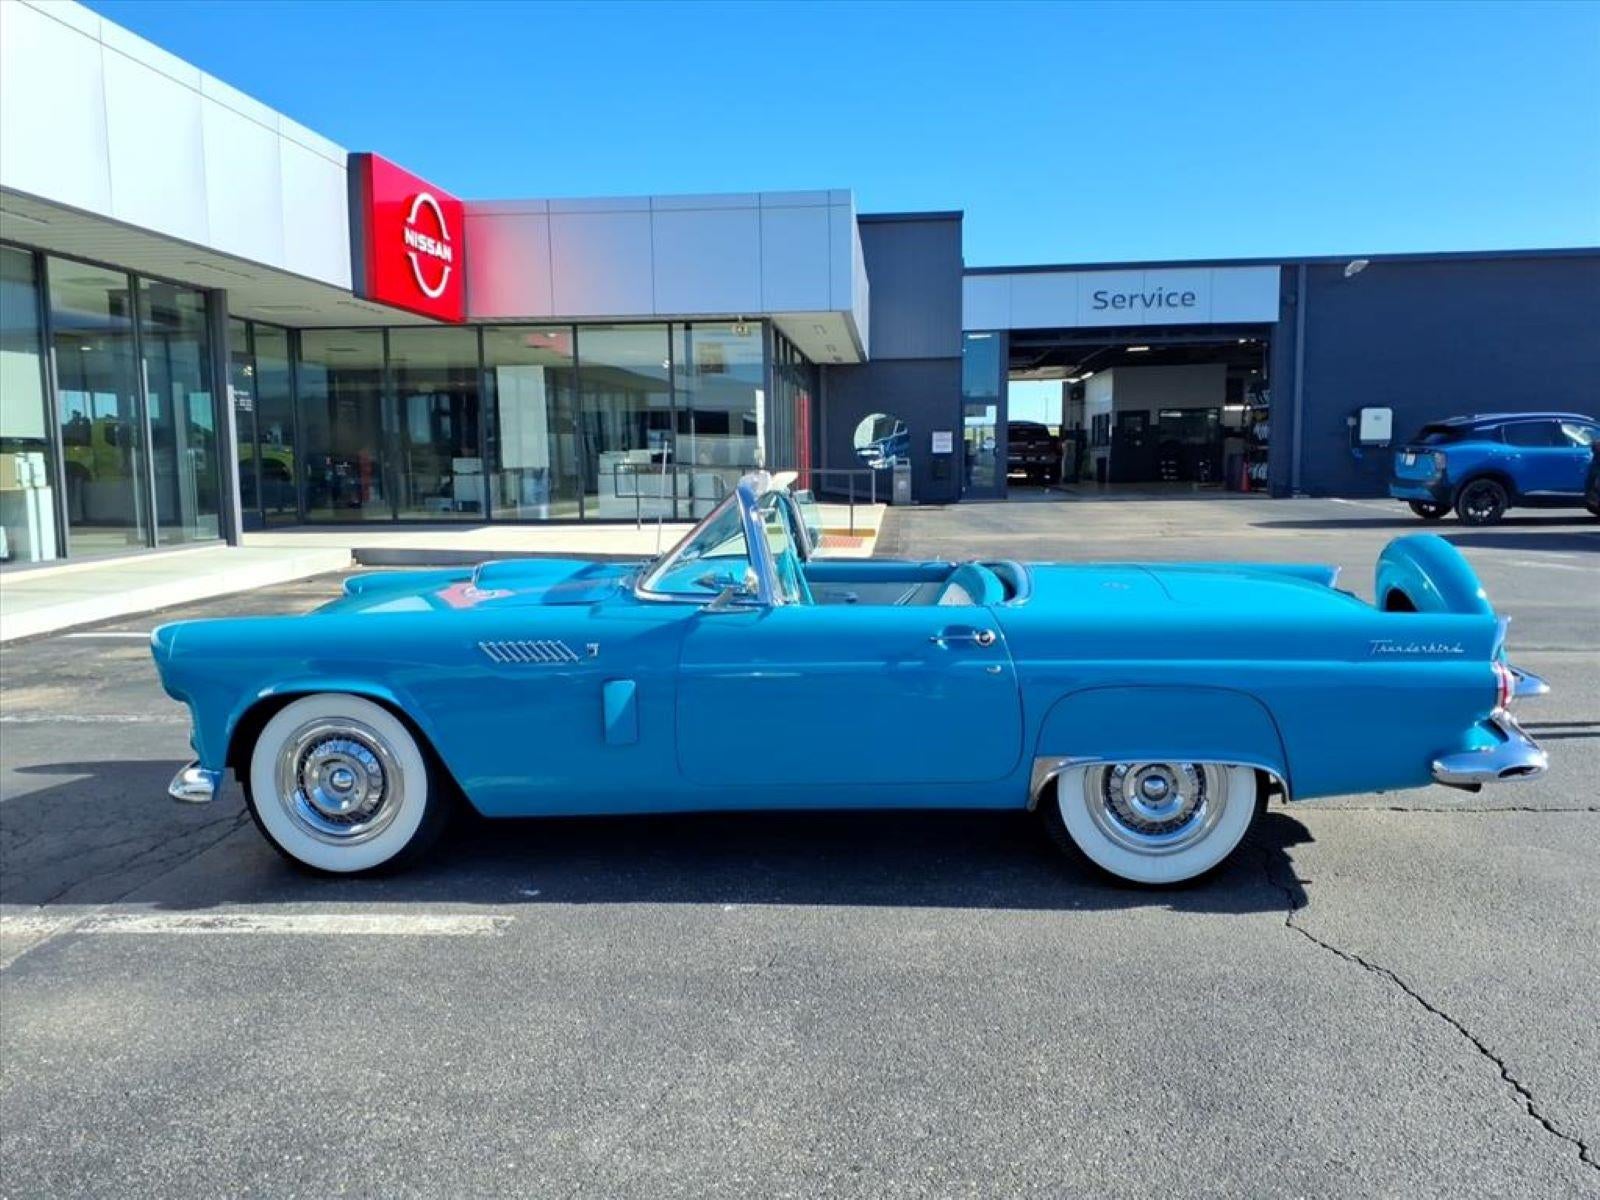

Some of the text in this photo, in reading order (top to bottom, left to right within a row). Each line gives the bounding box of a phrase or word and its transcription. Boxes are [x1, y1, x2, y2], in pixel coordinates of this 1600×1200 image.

[404, 227, 452, 262] NISSAN
[1092, 286, 1196, 310] Service
[1370, 639, 1464, 655] Thunderbird
